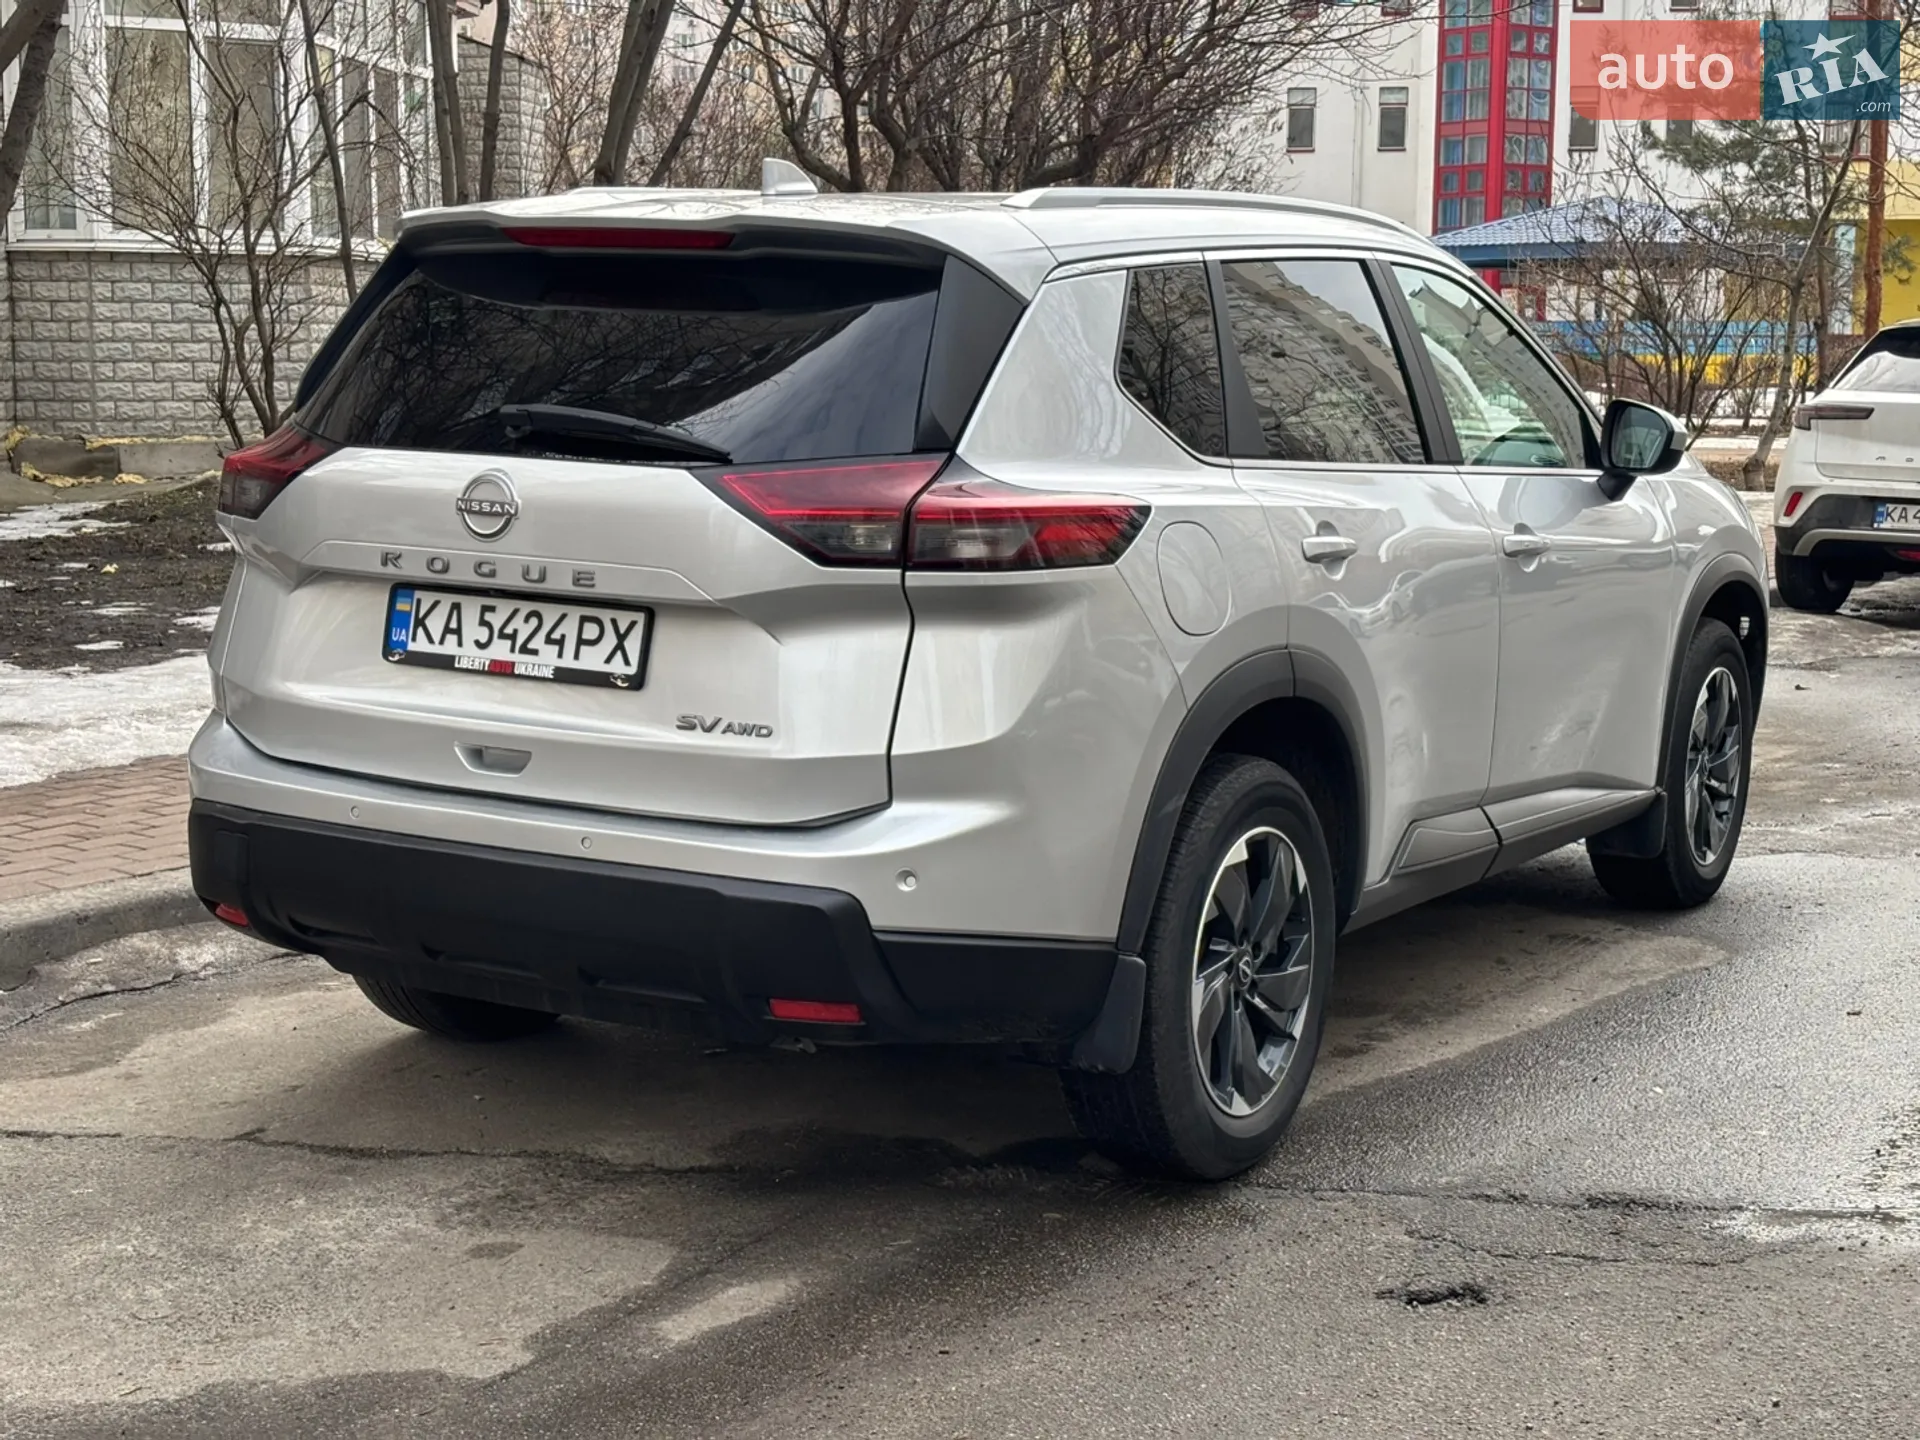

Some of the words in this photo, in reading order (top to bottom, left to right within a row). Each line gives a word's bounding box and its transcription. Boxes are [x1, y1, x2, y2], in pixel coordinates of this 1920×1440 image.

[457, 500, 517, 515] NISSAN
[380, 550, 597, 588] ROGUE
[391, 627, 408, 643] UA
[513, 662, 556, 679] UKRAINE
[675, 713, 723, 734] SV
[720, 721, 774, 738] AWD
